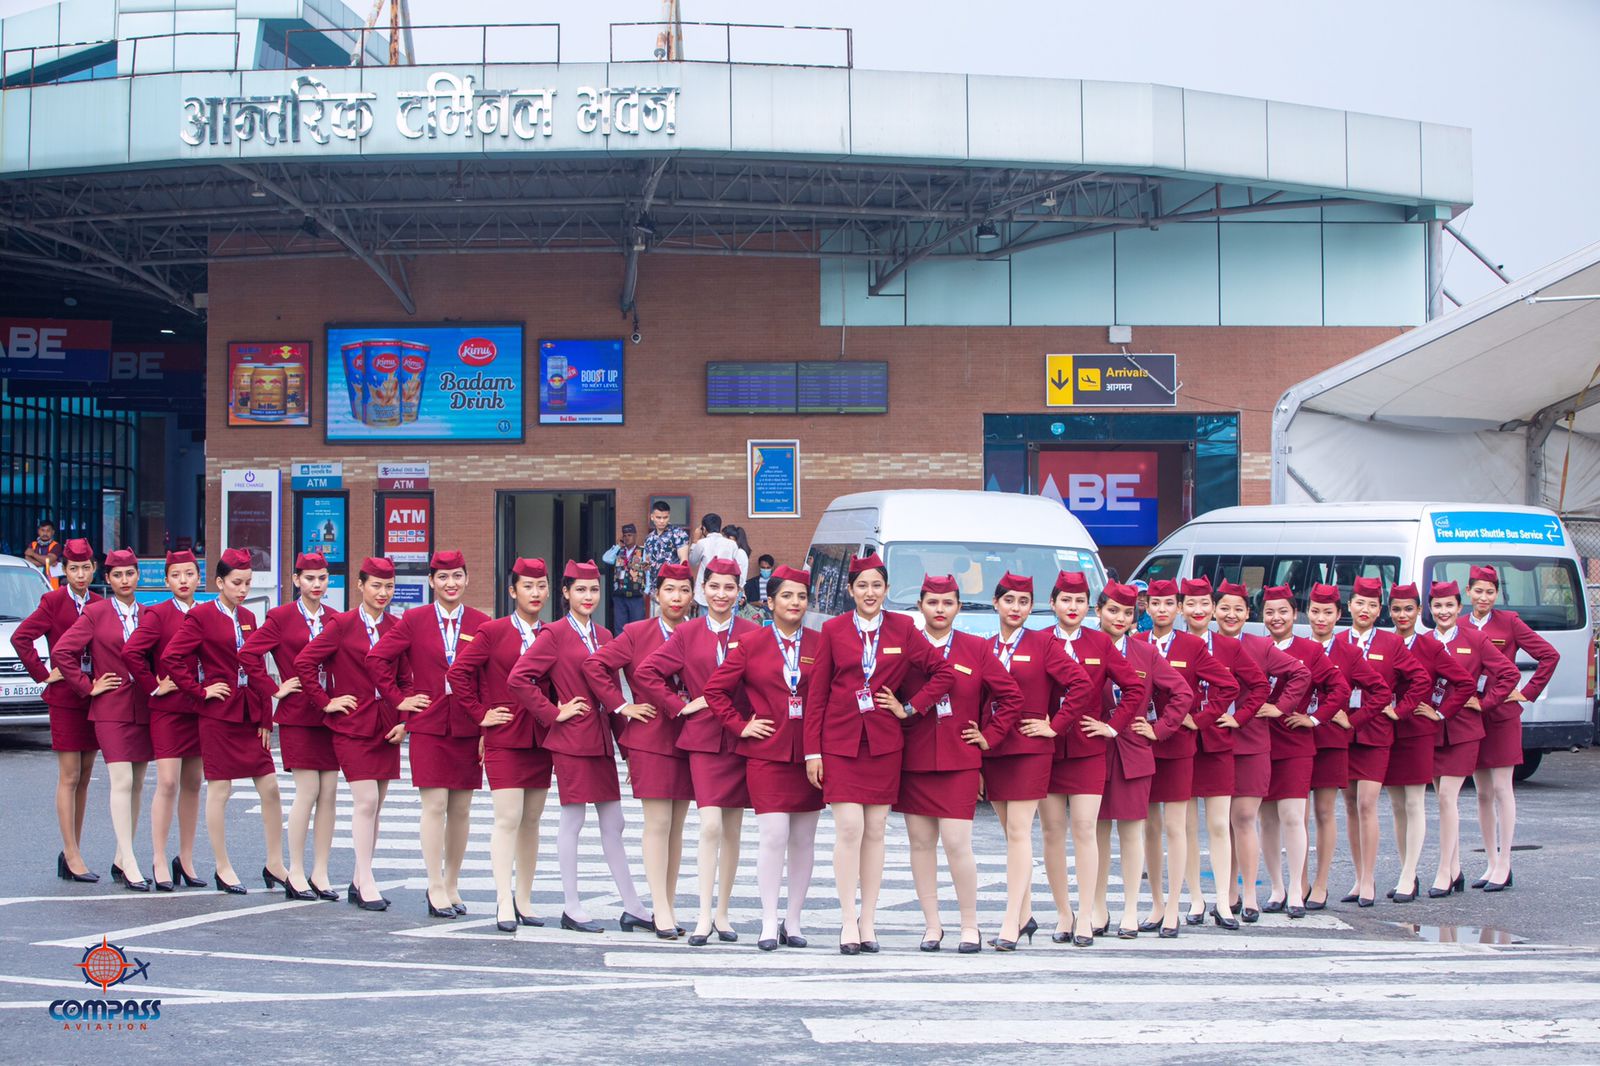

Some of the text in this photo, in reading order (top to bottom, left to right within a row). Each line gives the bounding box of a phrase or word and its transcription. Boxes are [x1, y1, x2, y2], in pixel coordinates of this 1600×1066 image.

[180, 72, 680, 146] आन्तरिक टर्मिनल भवन
[0, 326, 67, 360] BE
[581, 369, 605, 383] BOOST
[608, 370, 618, 382] UP
[1105, 367, 1149, 377] Arrivals
[439, 371, 516, 391] Badam
[1105, 383, 1133, 391] आगमन
[449, 390, 505, 410] Drink
[307, 478, 328, 488] ATM
[393, 480, 414, 489] ATM
[1039, 472, 1140, 511] ABE
[389, 509, 426, 524] ATM
[1437, 529, 1544, 540] Free Airport Shuttle Bus Service
